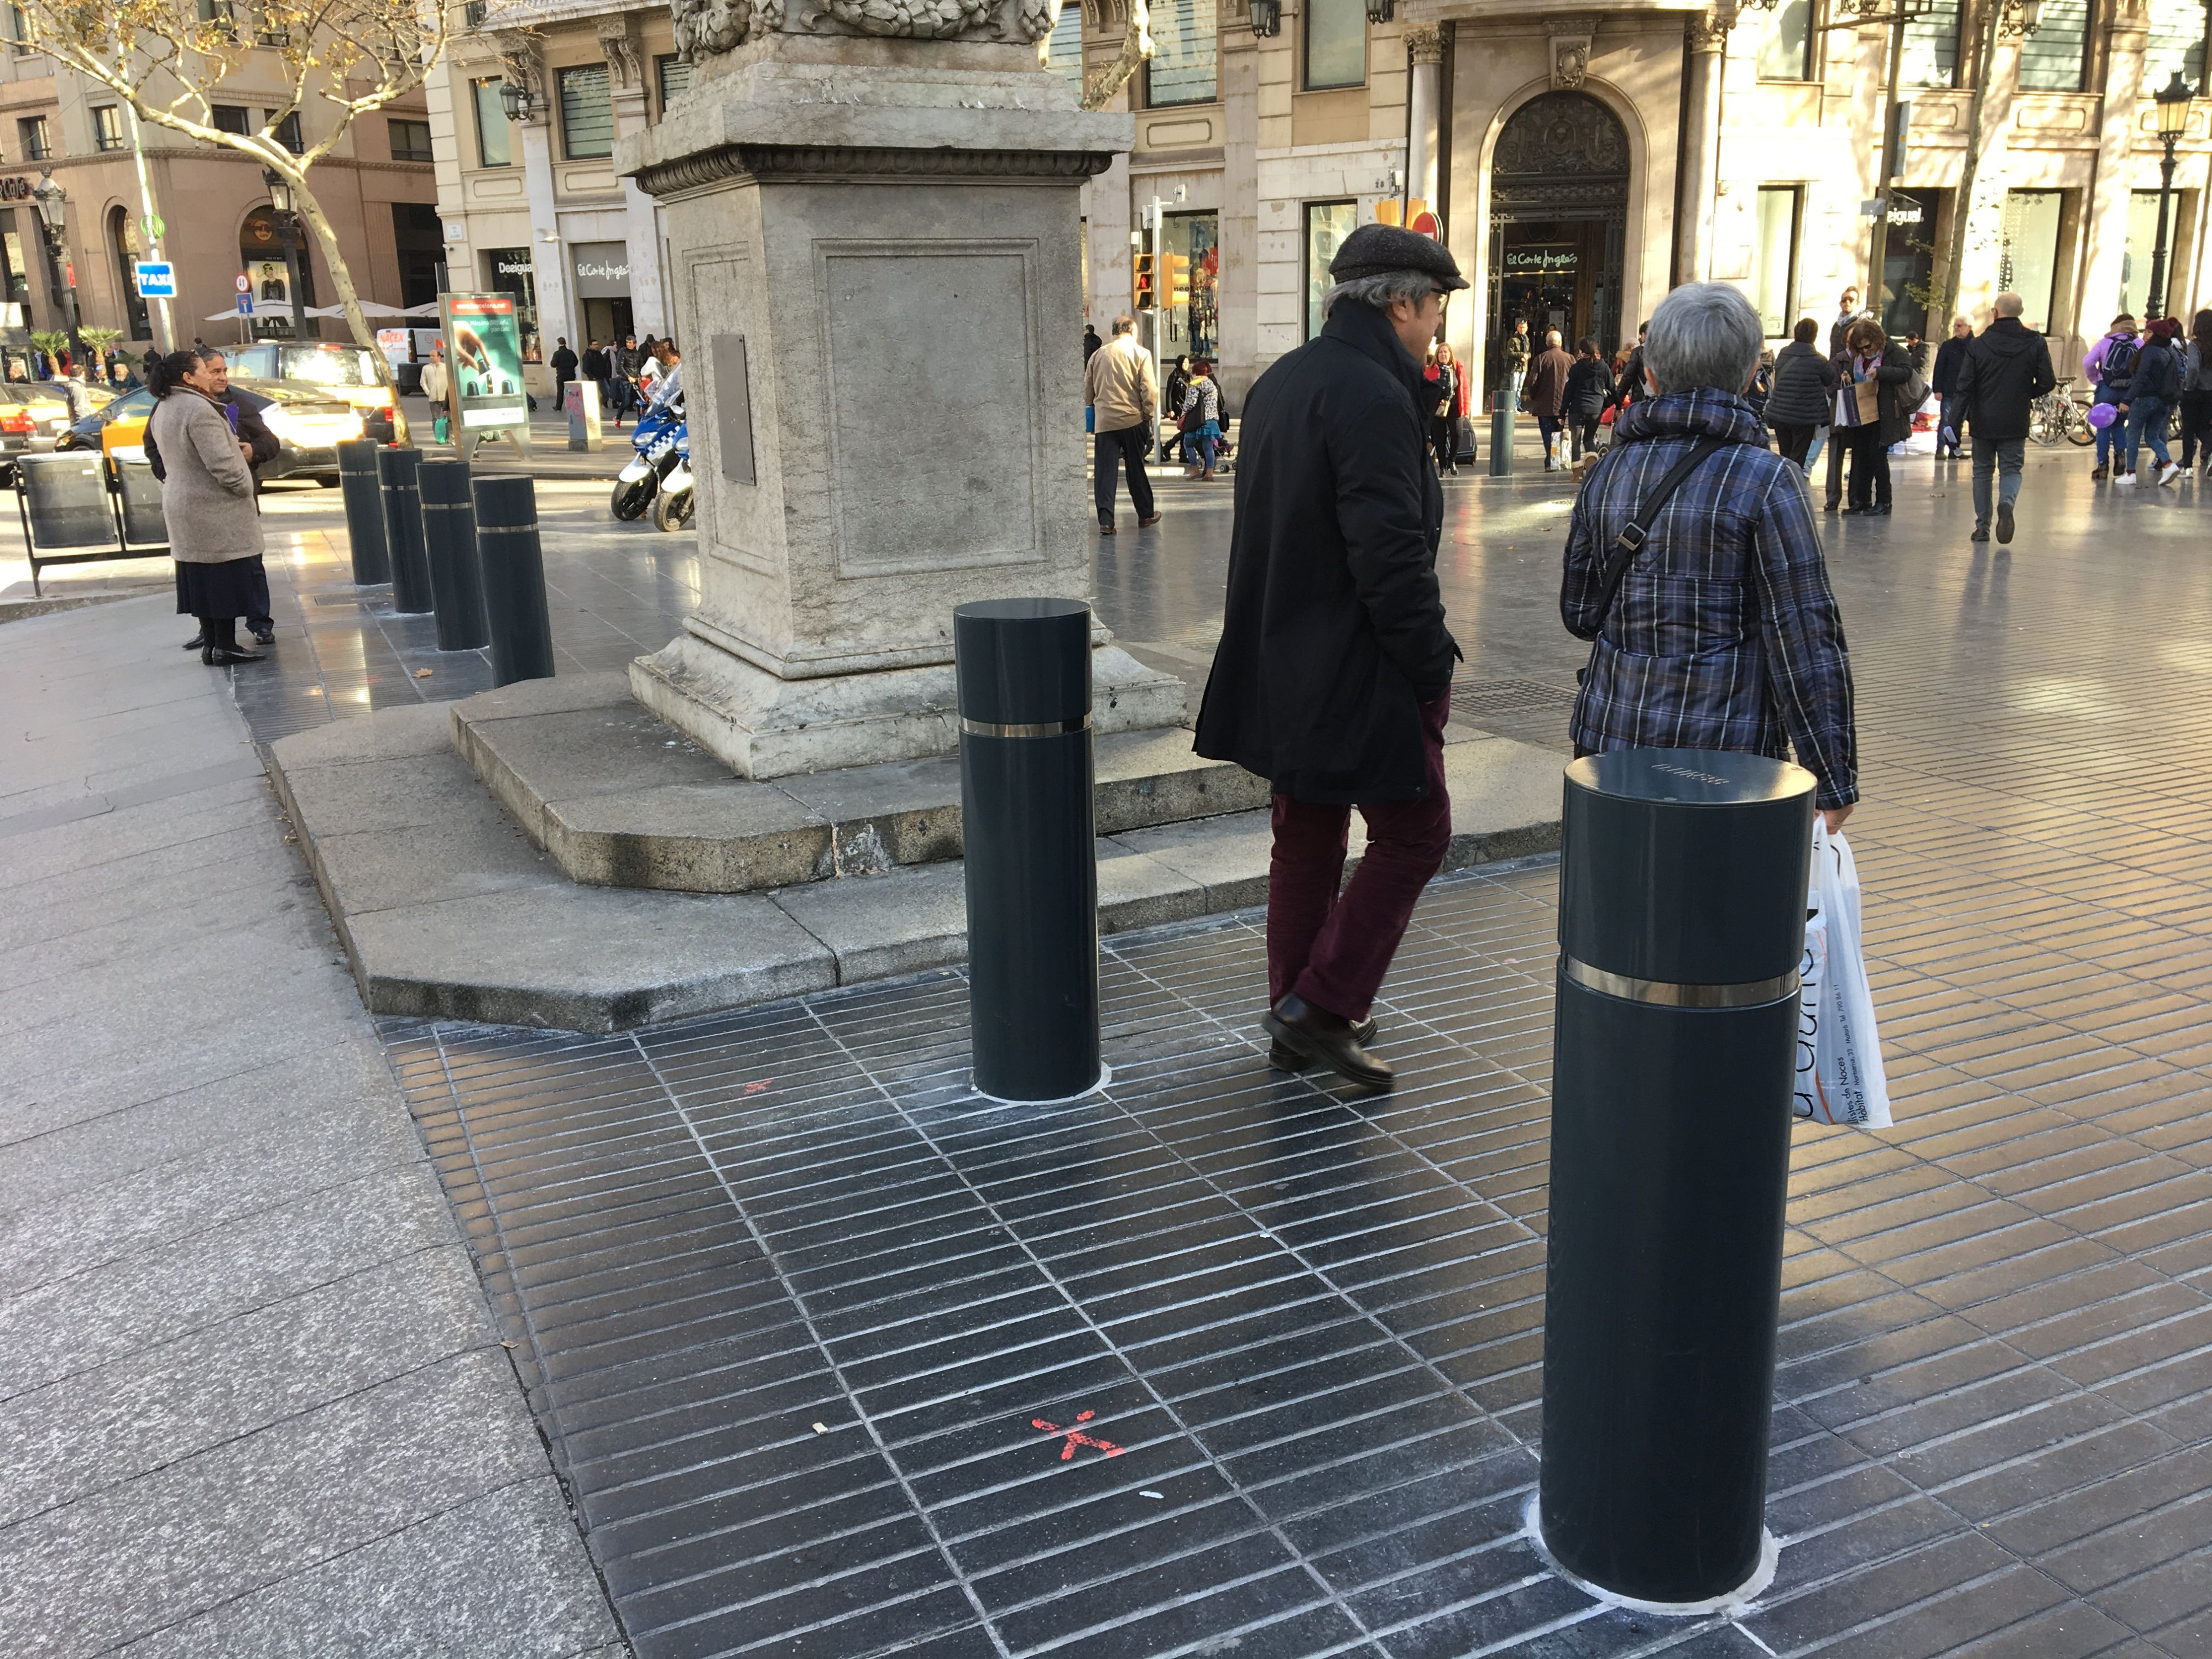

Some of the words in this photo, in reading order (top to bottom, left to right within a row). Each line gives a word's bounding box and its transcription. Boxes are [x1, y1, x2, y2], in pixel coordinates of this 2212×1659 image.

[1506, 253, 1517, 264] El
[1517, 253, 1542, 264] Corte
[1542, 250, 1578, 268] Inglés
[577, 263, 586, 276] El
[586, 263, 605, 276] Corte
[139, 273, 173, 286] TAXI
[1837, 1056, 1850, 1086] Noces
[1841, 1087, 1851, 1099] de
